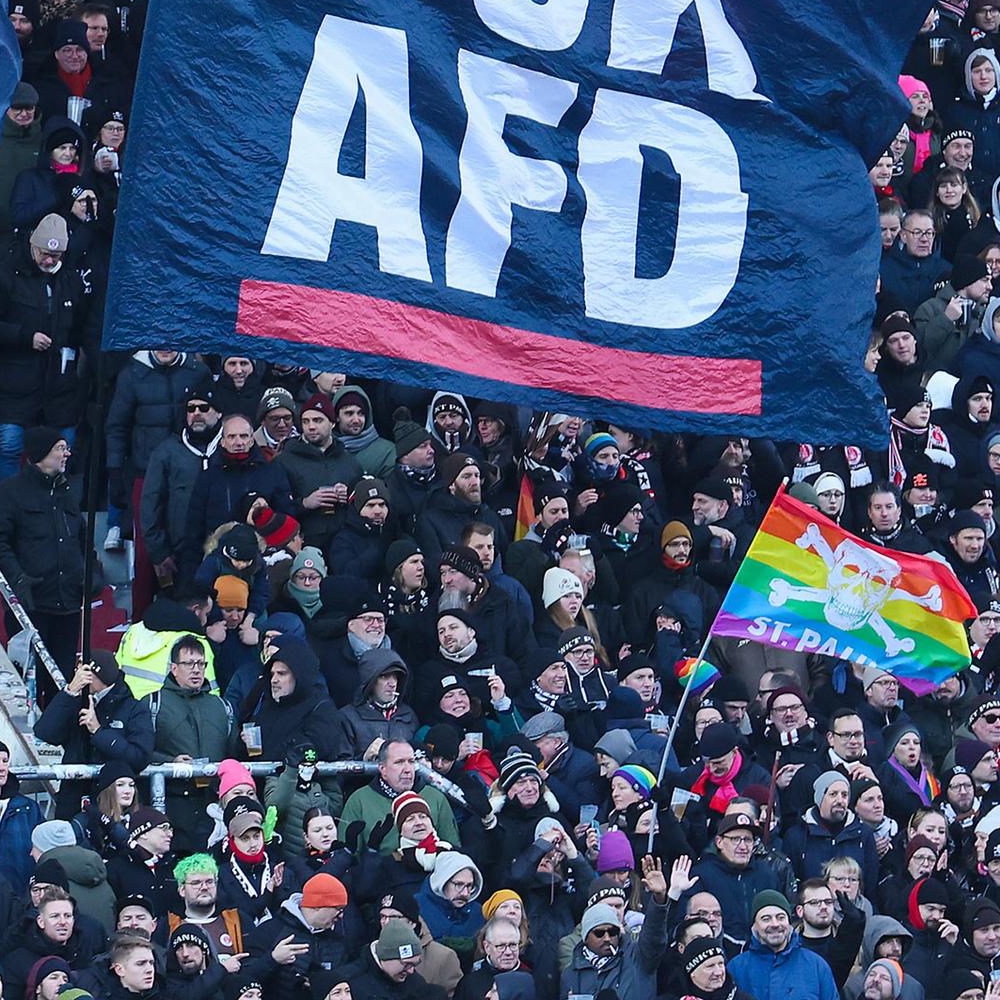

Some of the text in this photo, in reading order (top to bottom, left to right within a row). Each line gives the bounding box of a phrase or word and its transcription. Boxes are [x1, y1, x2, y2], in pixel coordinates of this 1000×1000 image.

[260, 14, 749, 330] AFD
[747, 616, 791, 647] ST.
[685, 947, 715, 973] SANKT
